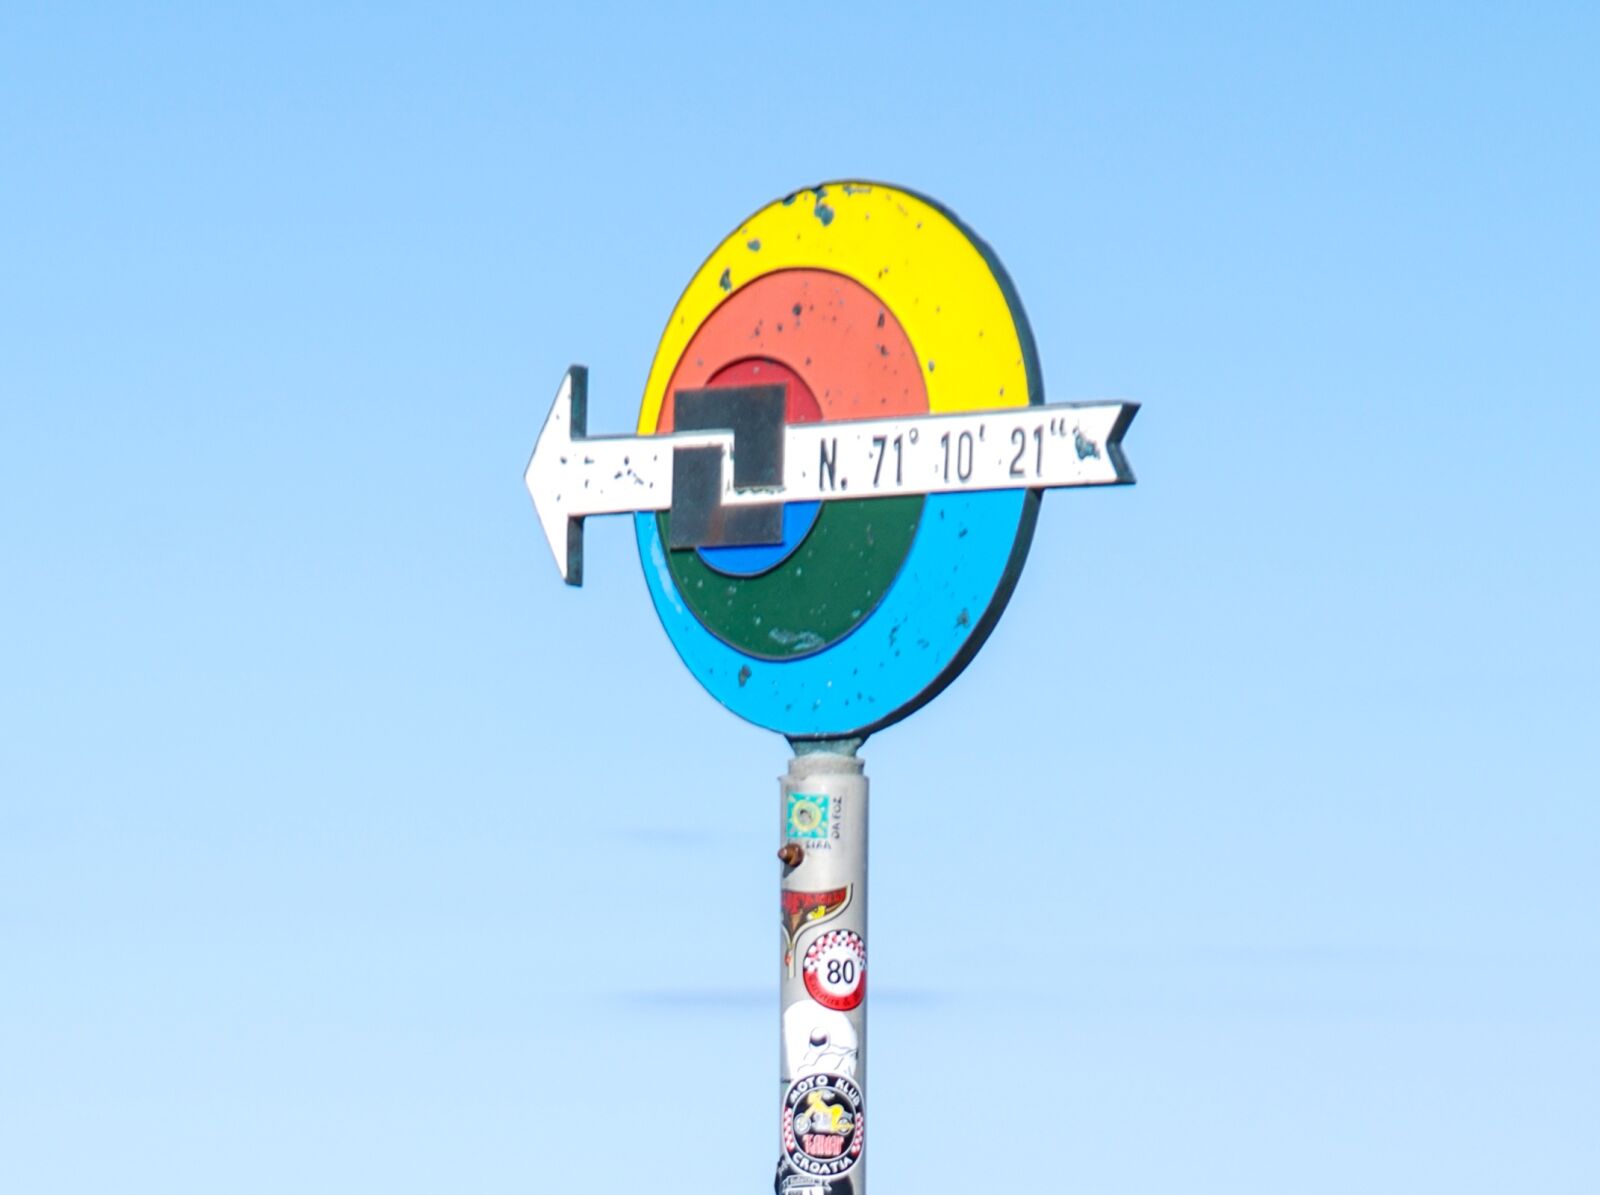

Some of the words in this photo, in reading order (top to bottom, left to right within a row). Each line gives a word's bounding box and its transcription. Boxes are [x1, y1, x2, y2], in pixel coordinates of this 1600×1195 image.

[819, 438, 847, 491] N.
[873, 428, 918, 487] 71°
[941, 424, 985, 482] 10'
[827, 959, 855, 984] 80
[790, 1075, 828, 1102] MOTO
[793, 1152, 853, 1174] CROATIA
